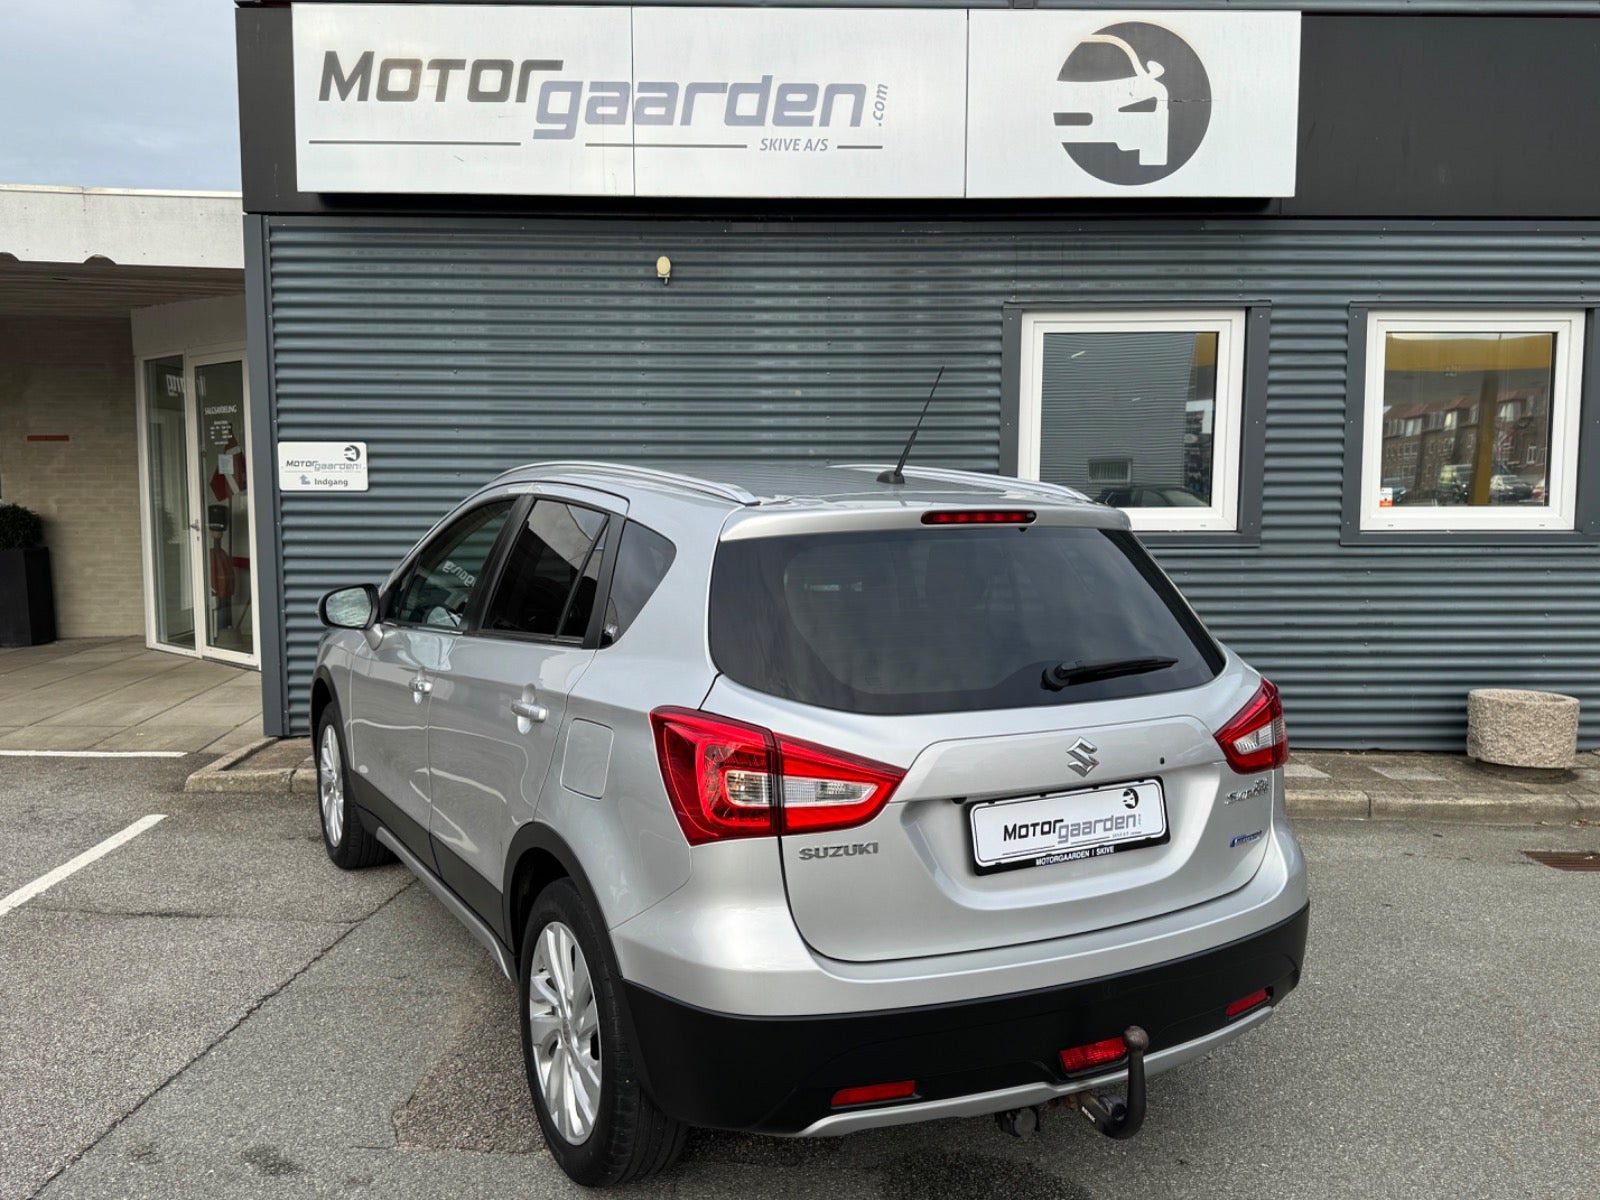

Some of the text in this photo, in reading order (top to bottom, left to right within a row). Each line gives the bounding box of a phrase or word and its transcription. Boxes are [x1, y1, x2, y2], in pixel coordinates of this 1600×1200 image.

[872, 83, 889, 127] .com
[759, 138, 829, 151] SKIVE A/S
[314, 477, 349, 487] Indgang
[799, 842, 879, 860] SUZUKI
[1036, 849, 1089, 866] MOTORGAARDEN
[1096, 846, 1115, 855] SKIVE
